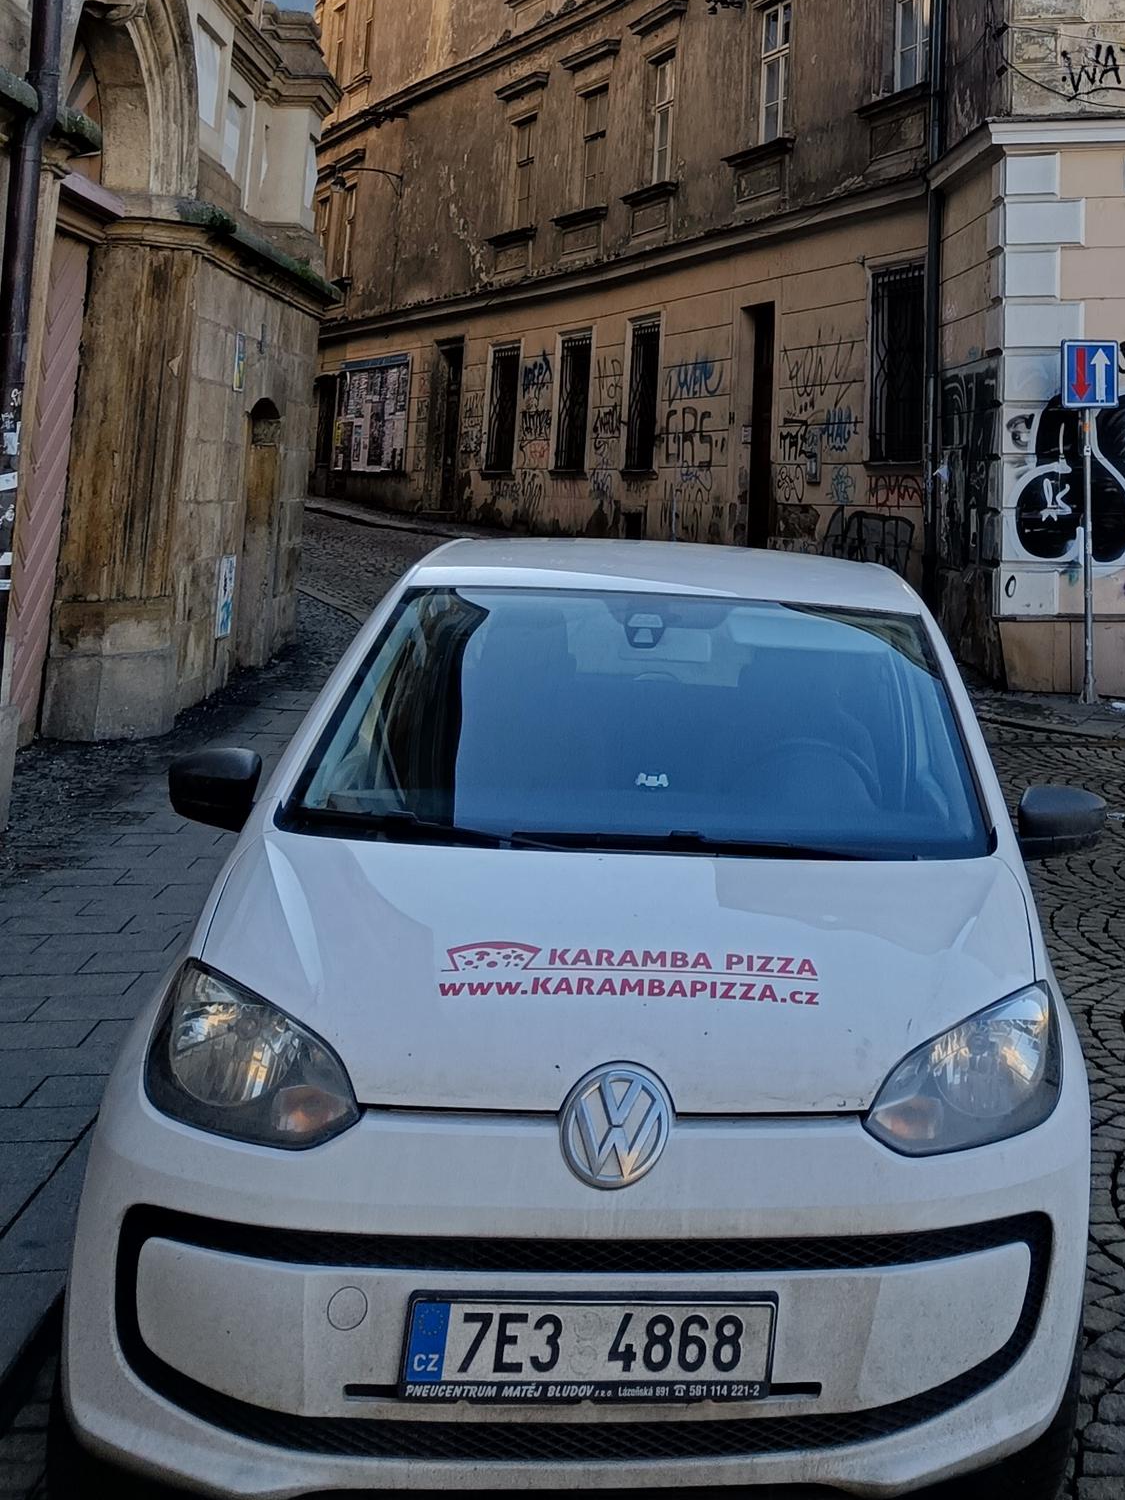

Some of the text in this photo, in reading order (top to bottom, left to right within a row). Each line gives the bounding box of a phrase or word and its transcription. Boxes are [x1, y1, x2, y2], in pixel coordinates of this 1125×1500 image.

[549, 948, 818, 977] KARAMBA PIZZA
[438, 977, 820, 1006] www.KARAMBAPIZZA.cz
[457, 1312, 744, 1373] 7E3 4868
[413, 1354, 440, 1372] CZ
[405, 1385, 497, 1398] PNEUCENTRUM
[501, 1383, 543, 1398] MATĚJ
[547, 1385, 595, 1398] BLUDOV
[710, 1385, 728, 1397] 114
[731, 1385, 760, 1397] 221-2
